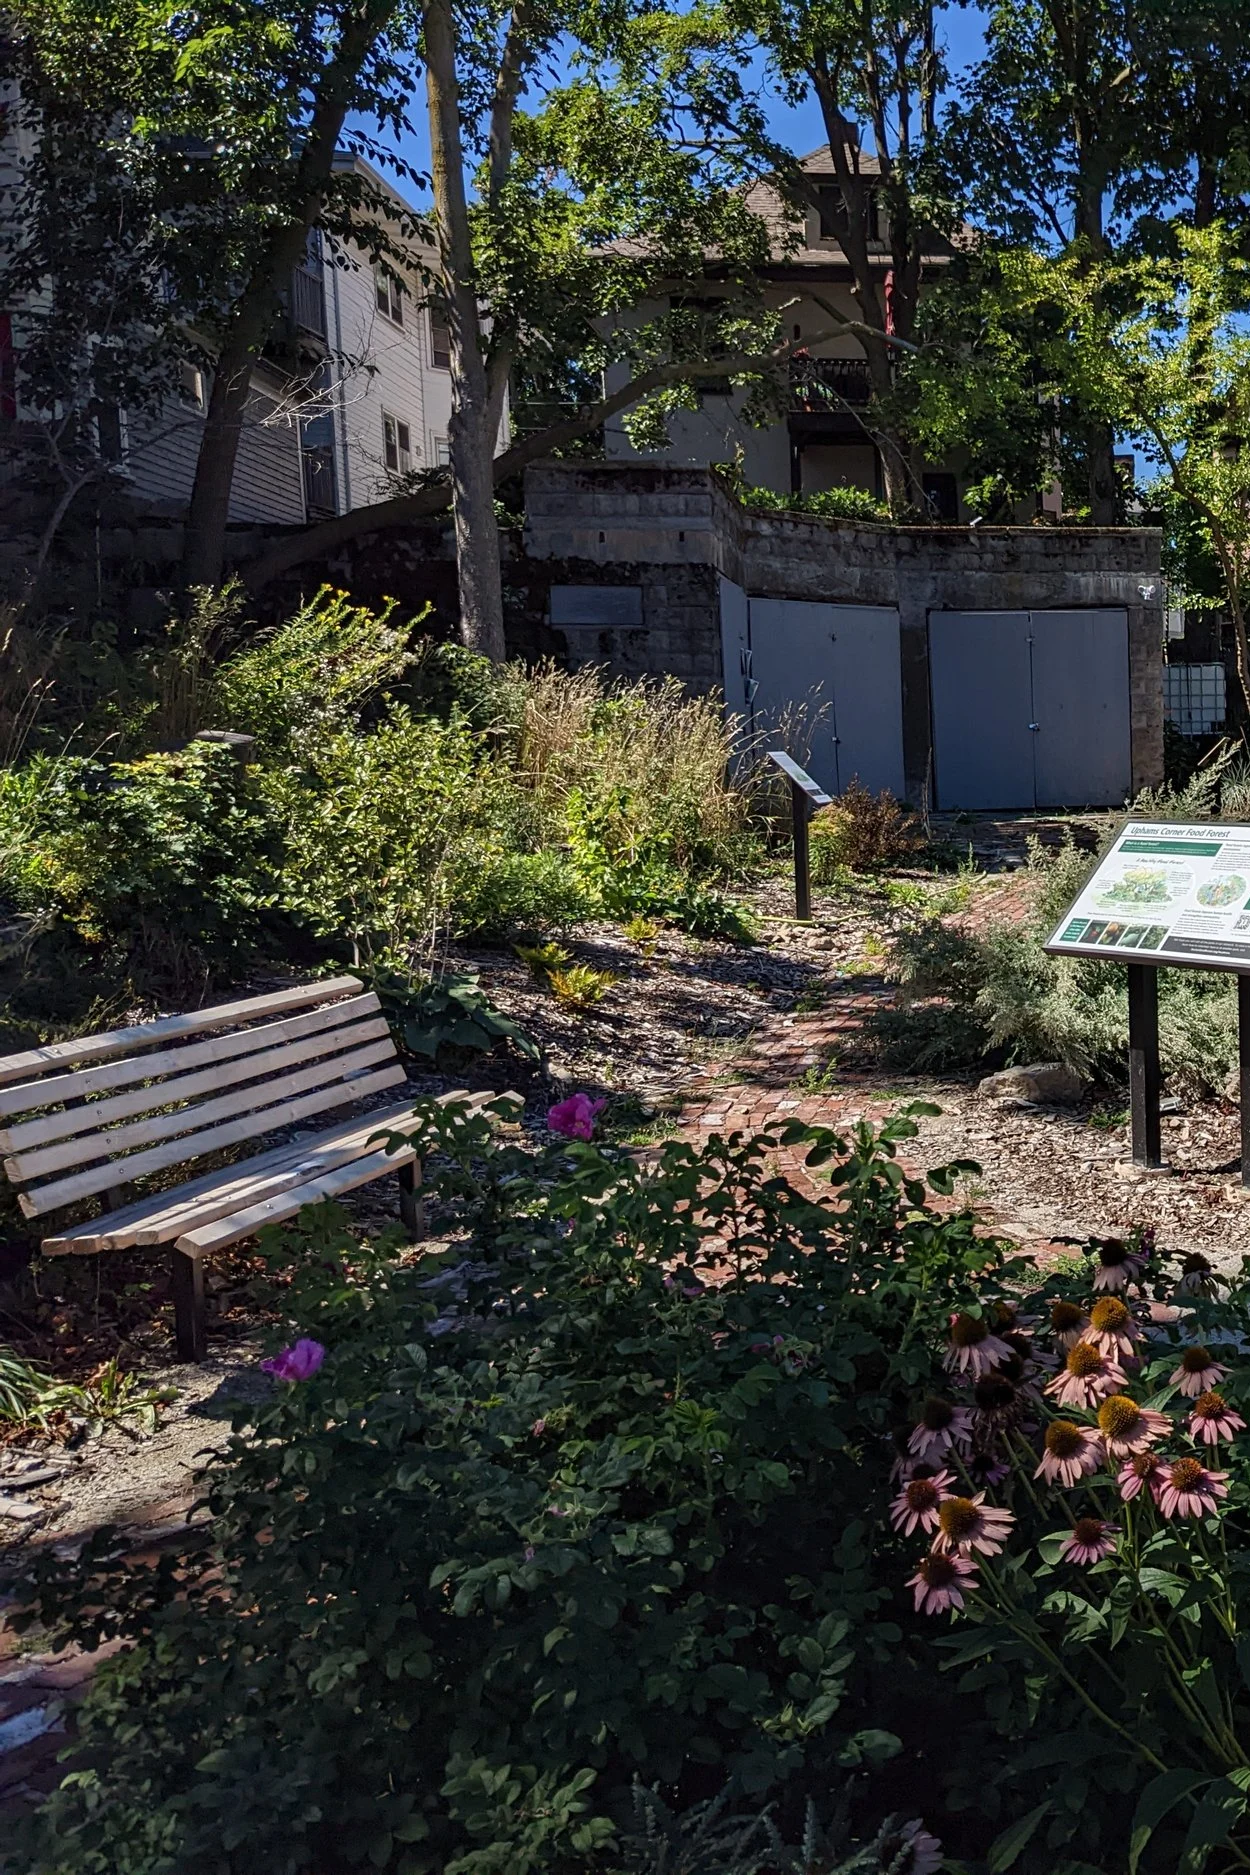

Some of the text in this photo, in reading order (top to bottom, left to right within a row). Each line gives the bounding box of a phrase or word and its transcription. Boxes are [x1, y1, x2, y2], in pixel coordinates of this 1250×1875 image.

[1131, 826, 1230, 837] Uphams Corner Food Forest
